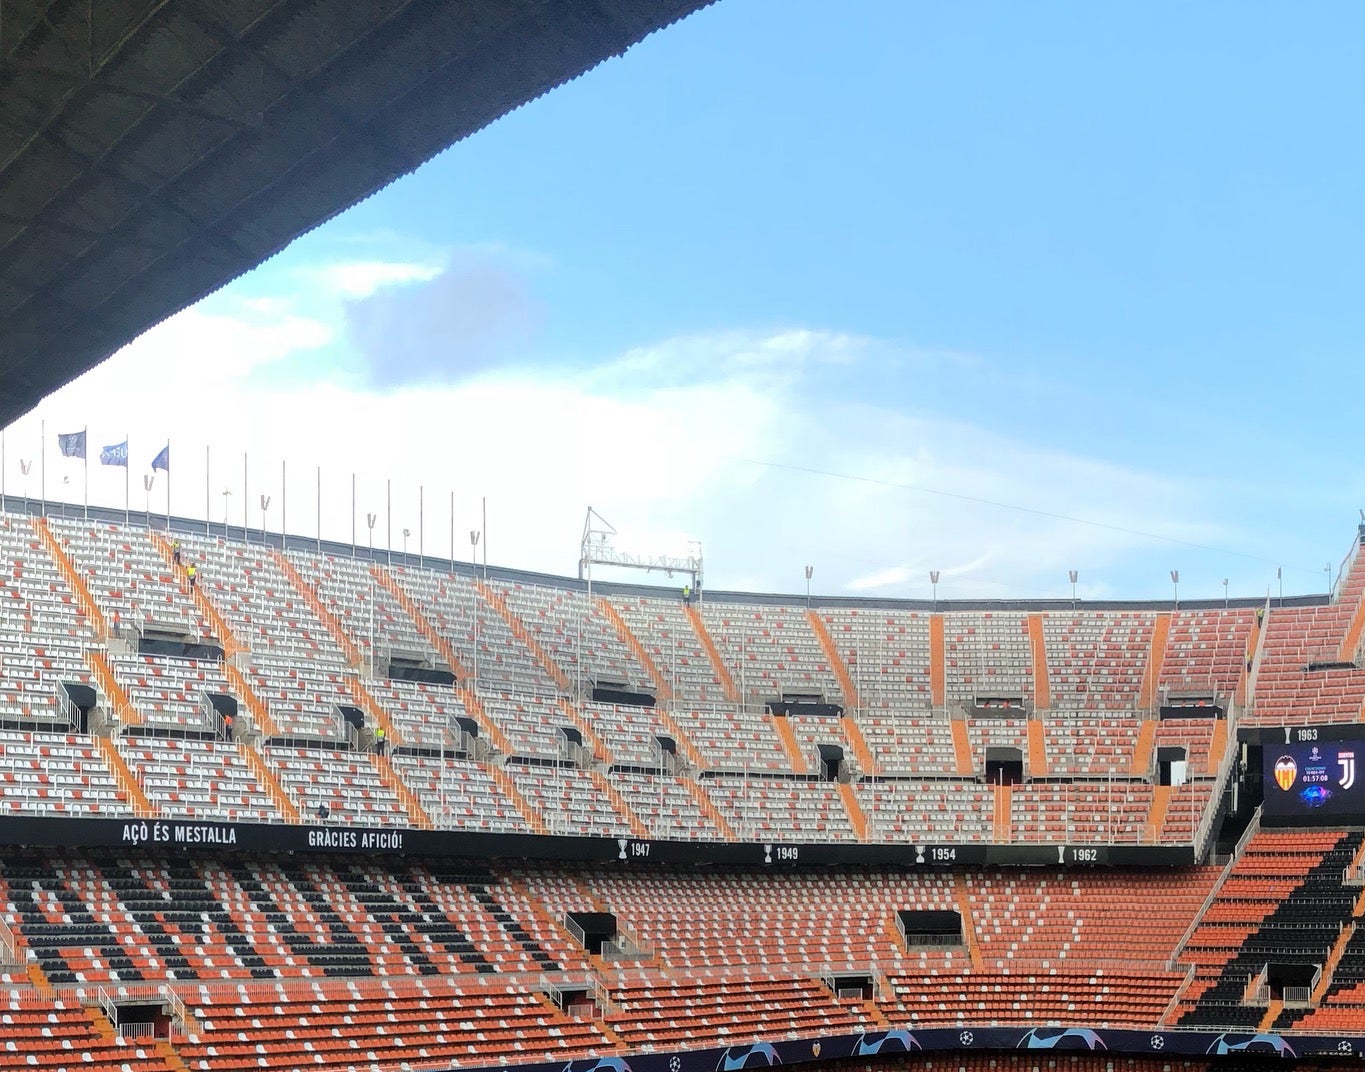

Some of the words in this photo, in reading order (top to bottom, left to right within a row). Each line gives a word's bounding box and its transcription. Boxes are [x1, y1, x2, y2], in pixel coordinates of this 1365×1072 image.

[1297, 729, 1318, 742] 1963
[122, 821, 149, 845] AÇÒ
[154, 821, 170, 842] ÉS
[175, 826, 237, 845] MESTALLA
[308, 828, 357, 848] GRÀCIES
[361, 831, 403, 849] AFICIÓ!
[630, 842, 650, 857] 1947
[776, 847, 798, 860] 1949
[931, 848, 956, 861] 1954
[1072, 849, 1097, 862] 1962
